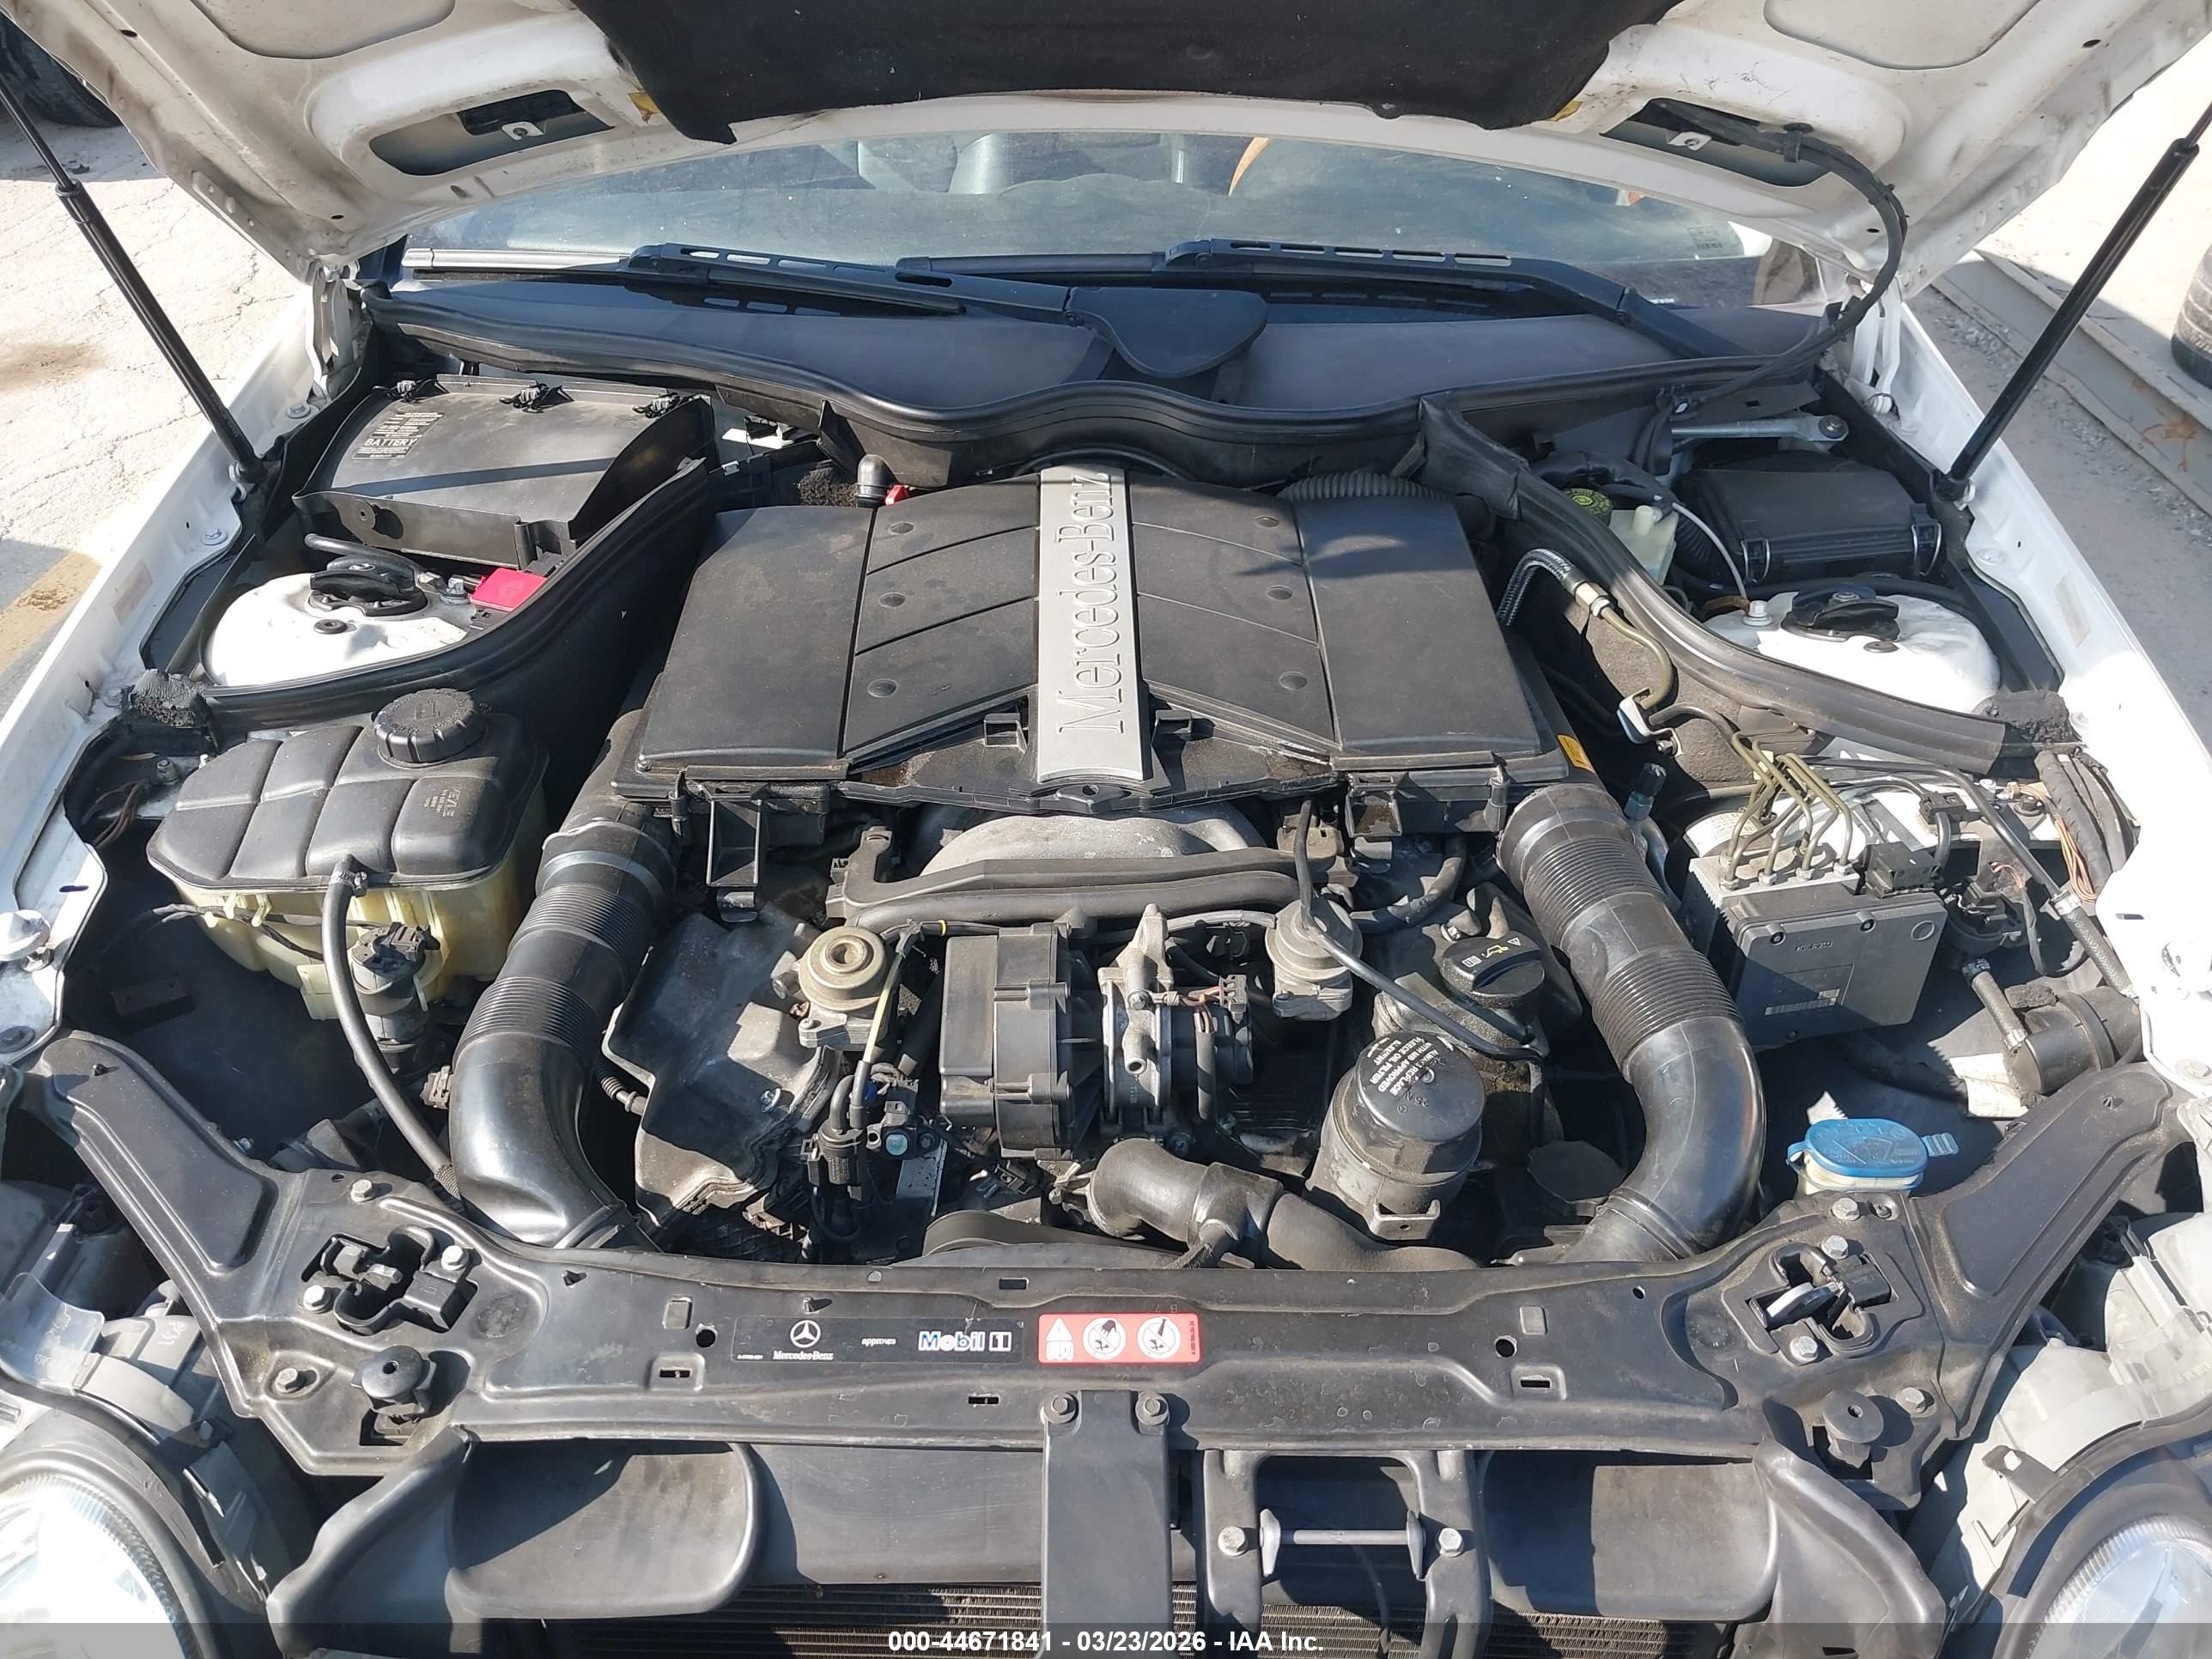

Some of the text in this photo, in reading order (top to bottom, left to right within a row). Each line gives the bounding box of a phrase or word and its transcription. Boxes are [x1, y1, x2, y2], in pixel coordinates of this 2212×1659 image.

[364, 438, 418, 447] BATTERY
[1056, 473, 1124, 733] Mercedes-Benz
[1389, 1054, 1402, 1066] OIL
[1369, 1063, 1393, 1085] FILTER
[1377, 1059, 1410, 1092] APPROVED
[773, 1350, 835, 1360] Mercedes-Benz
[861, 1337, 896, 1346] approves
[918, 1331, 986, 1352] Mobil
